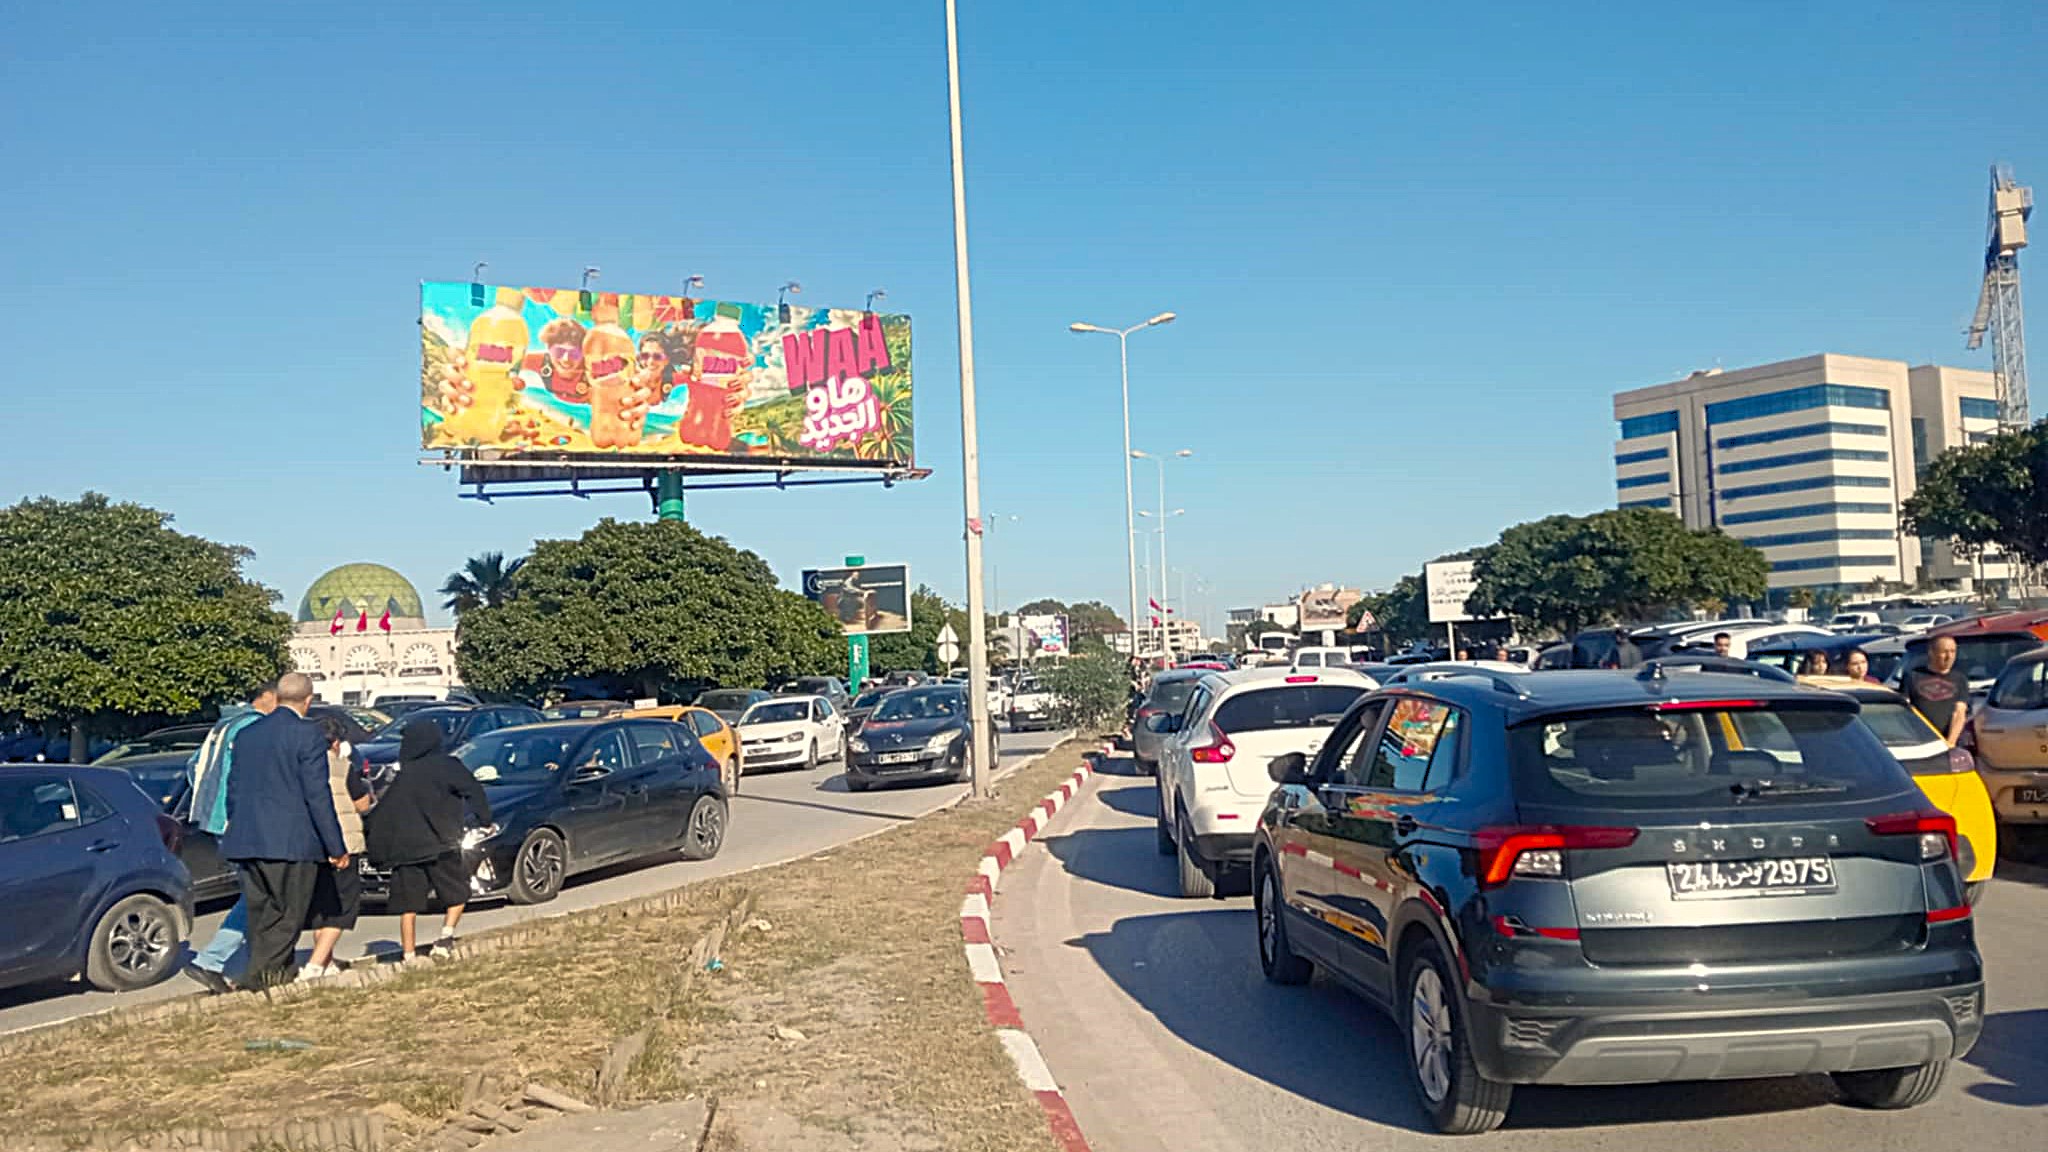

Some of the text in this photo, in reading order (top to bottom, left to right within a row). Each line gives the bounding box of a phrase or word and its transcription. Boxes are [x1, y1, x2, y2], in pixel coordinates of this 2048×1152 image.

[783, 312, 892, 394] WAA
[800, 398, 877, 447] الجديد
[1676, 862, 1726, 890] 244
[1763, 858, 1829, 886] 2975
